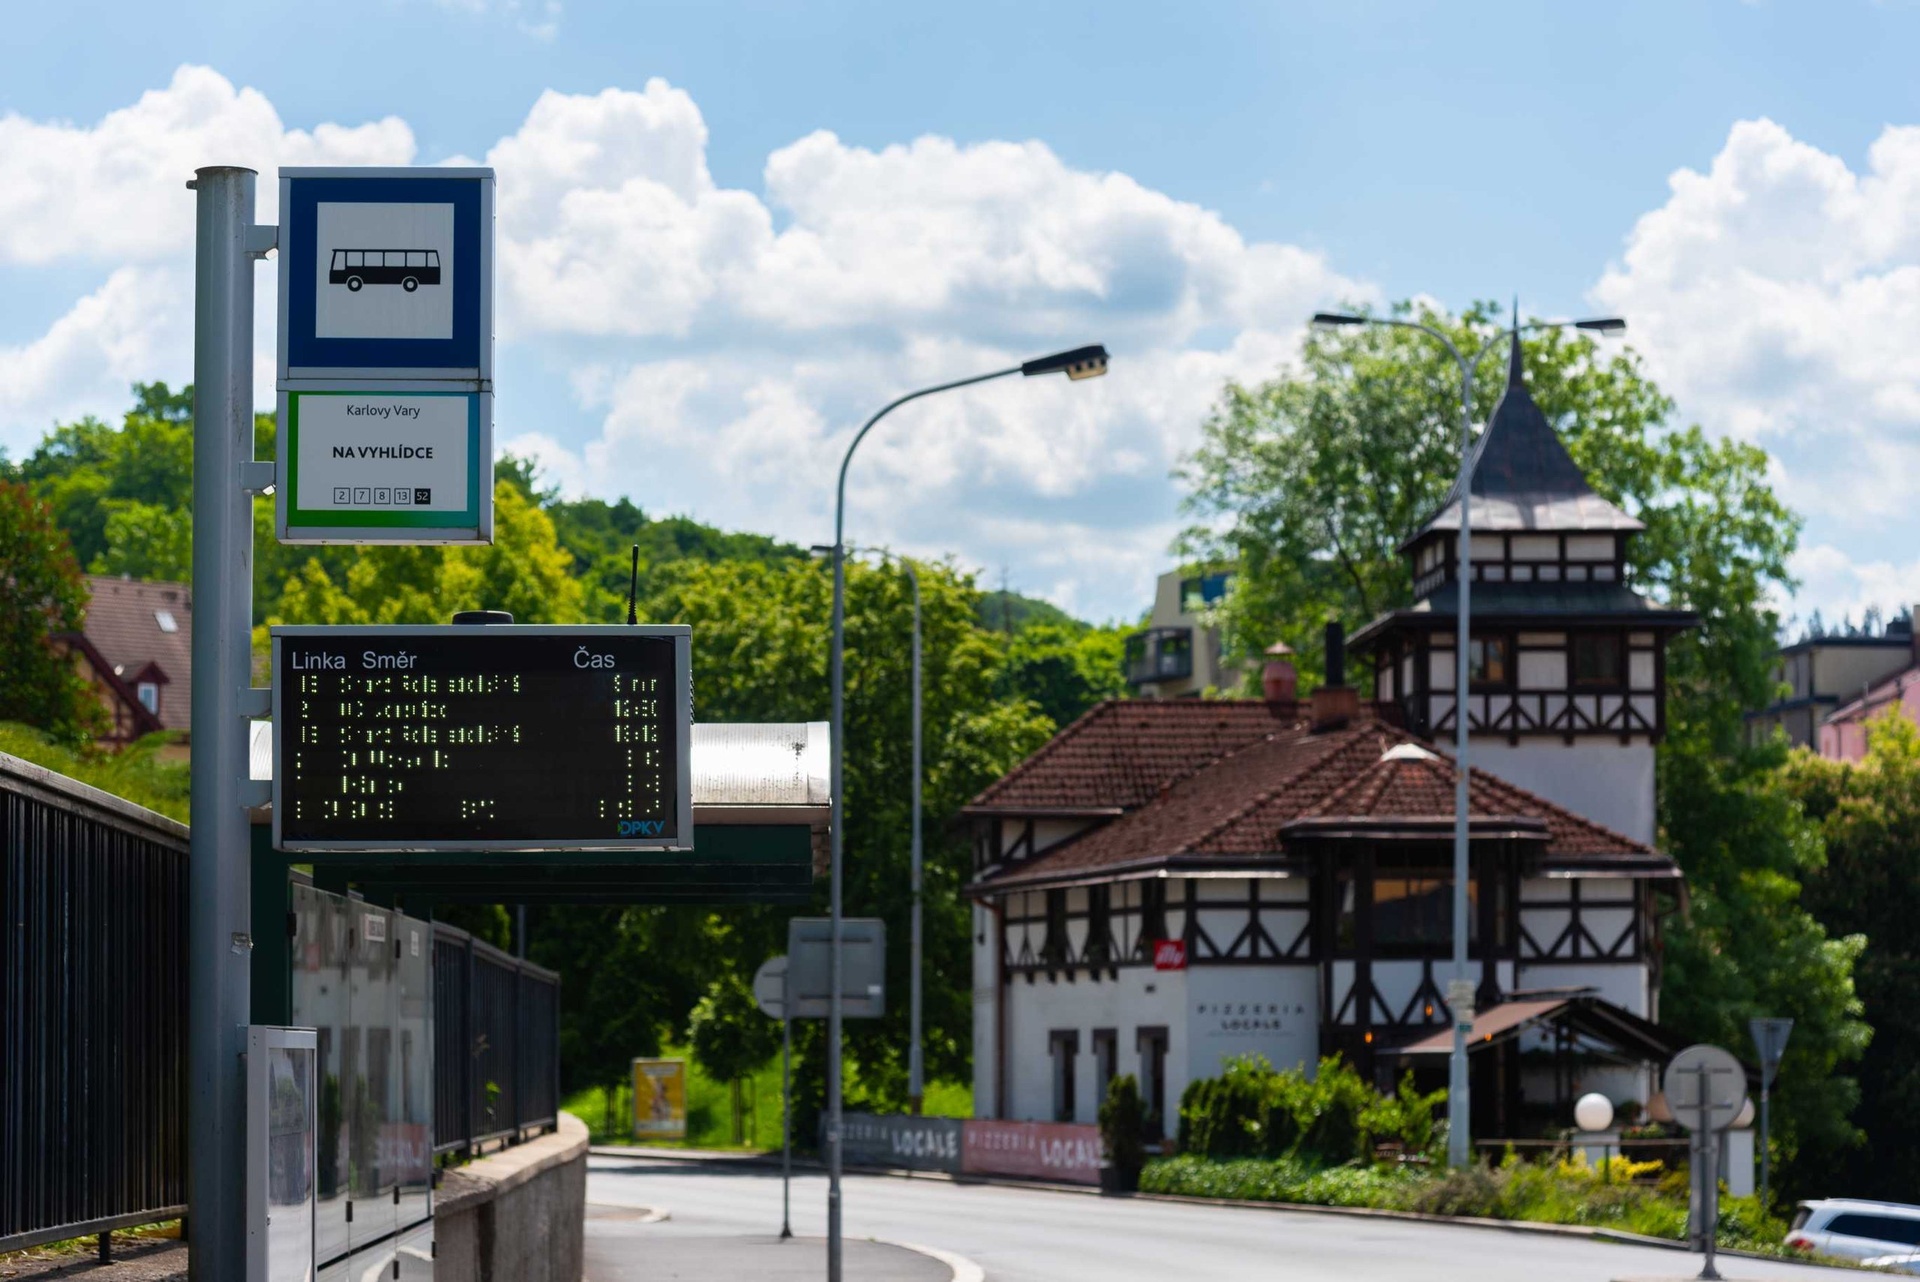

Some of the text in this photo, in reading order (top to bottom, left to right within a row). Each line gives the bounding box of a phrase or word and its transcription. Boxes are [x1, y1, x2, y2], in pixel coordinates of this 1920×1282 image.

[347, 404, 420, 419] Karlovy Vary
[333, 444, 433, 459] NA VYHLÍDCE
[338, 491, 428, 500] 2 7 8 13 52
[292, 650, 417, 670] Linka Směr
[573, 645, 615, 669] Čas
[619, 821, 666, 835] DPKV
[892, 1129, 957, 1160] LOCALE
